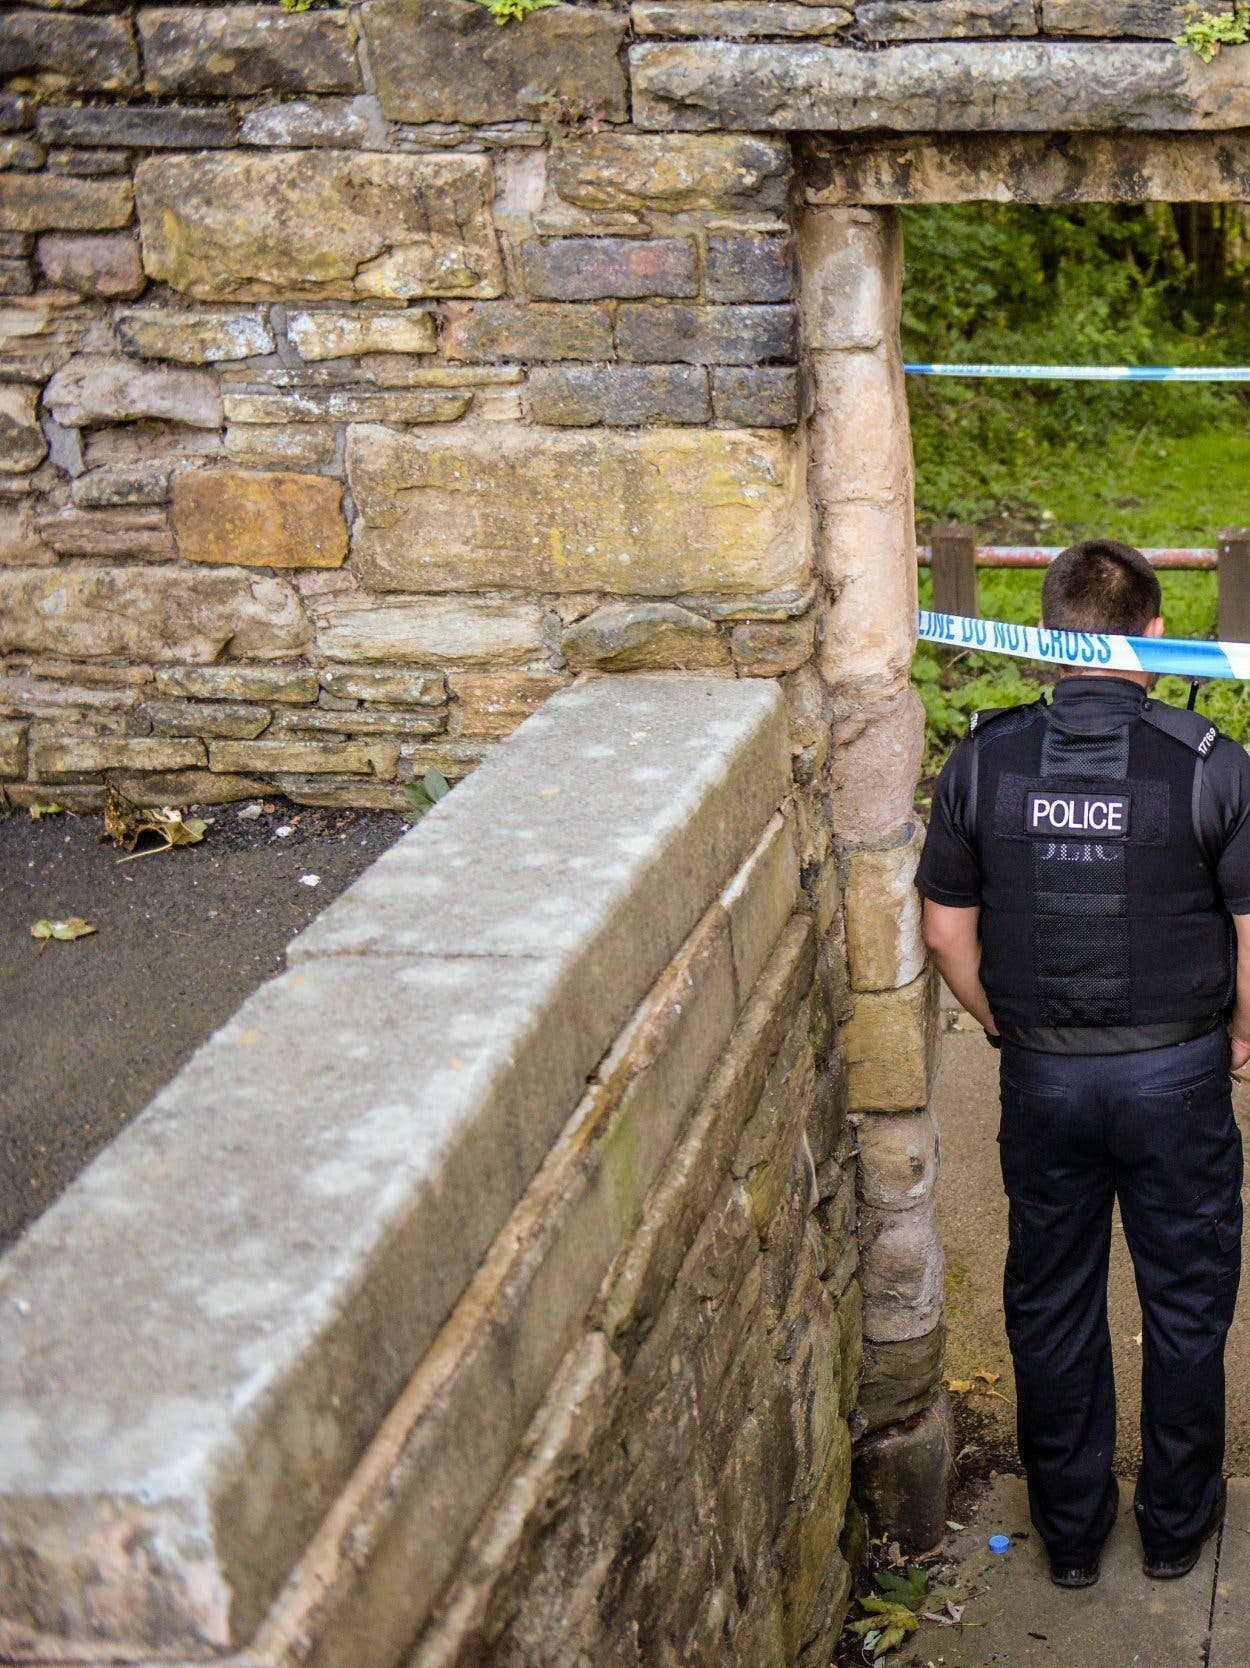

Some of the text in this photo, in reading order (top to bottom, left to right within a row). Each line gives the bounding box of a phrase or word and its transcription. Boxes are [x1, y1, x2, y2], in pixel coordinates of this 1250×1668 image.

[918, 611, 1112, 664] LINE DO NOT CROSS
[1198, 727, 1216, 755] 17769
[1032, 799, 1123, 830] POLICE
